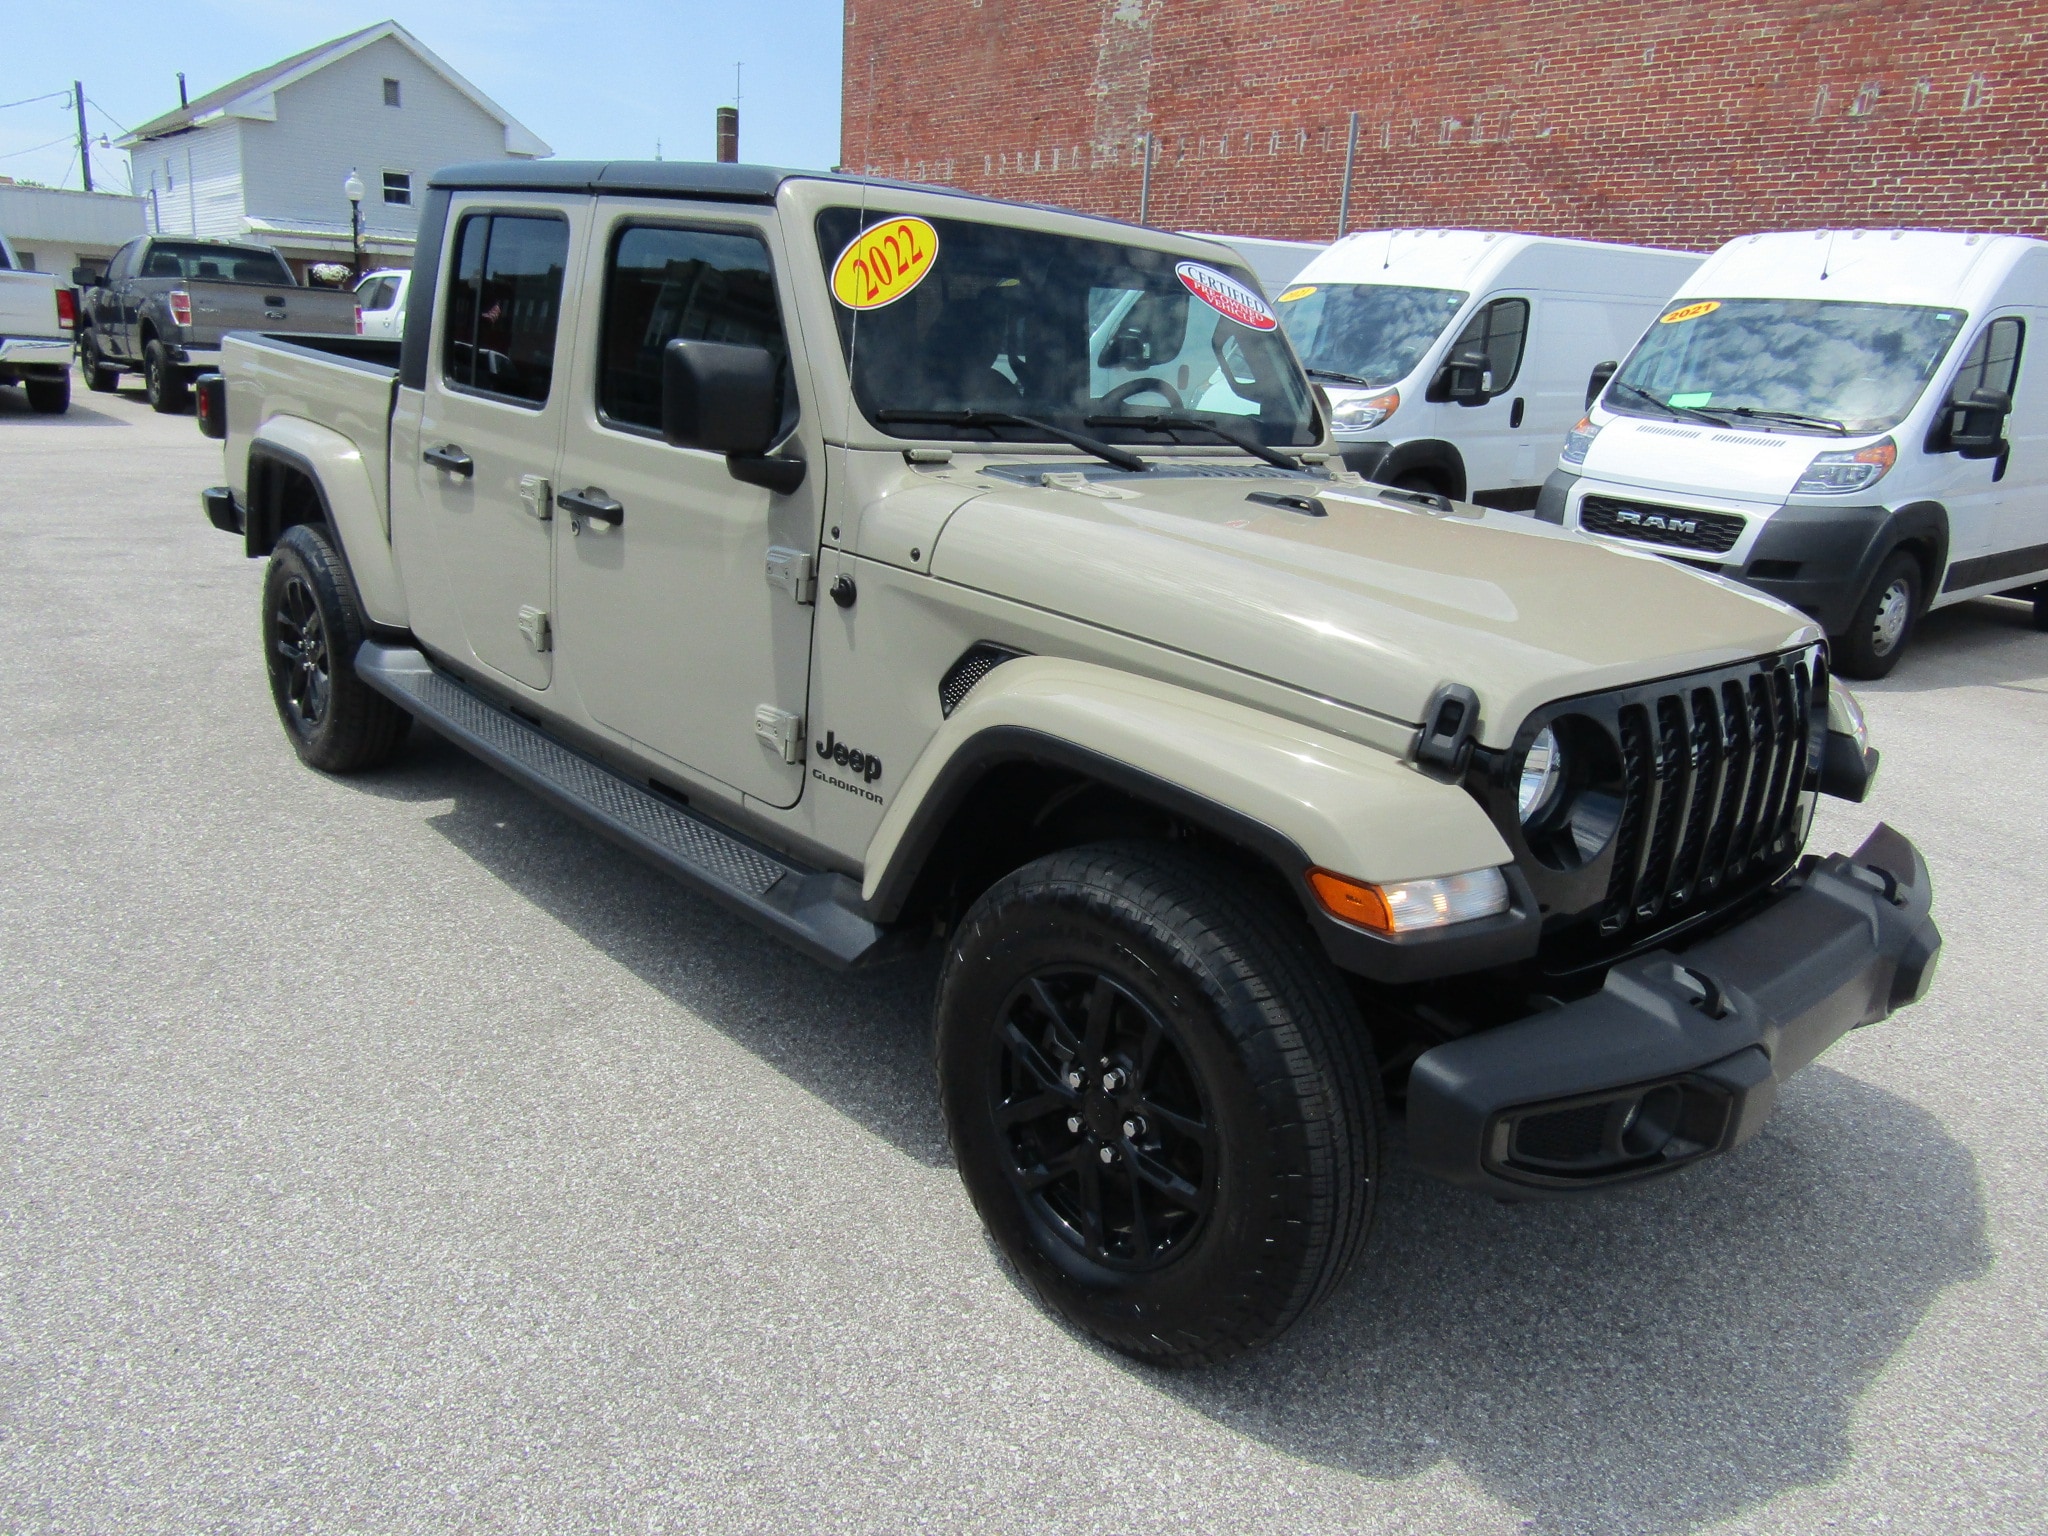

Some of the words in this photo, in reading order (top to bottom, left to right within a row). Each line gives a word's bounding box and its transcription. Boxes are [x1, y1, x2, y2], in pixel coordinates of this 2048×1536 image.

[852, 224, 924, 301] 2022
[1187, 266, 1265, 314] CERTIFIED
[1193, 281, 1264, 322] PRE-OWNED
[1206, 294, 1257, 325] VEHICLE
[1666, 302, 1713, 322] 2021
[1615, 510, 1697, 534] RAM
[815, 729, 882, 784] Jeep
[812, 768, 884, 805] GLADIATOR
